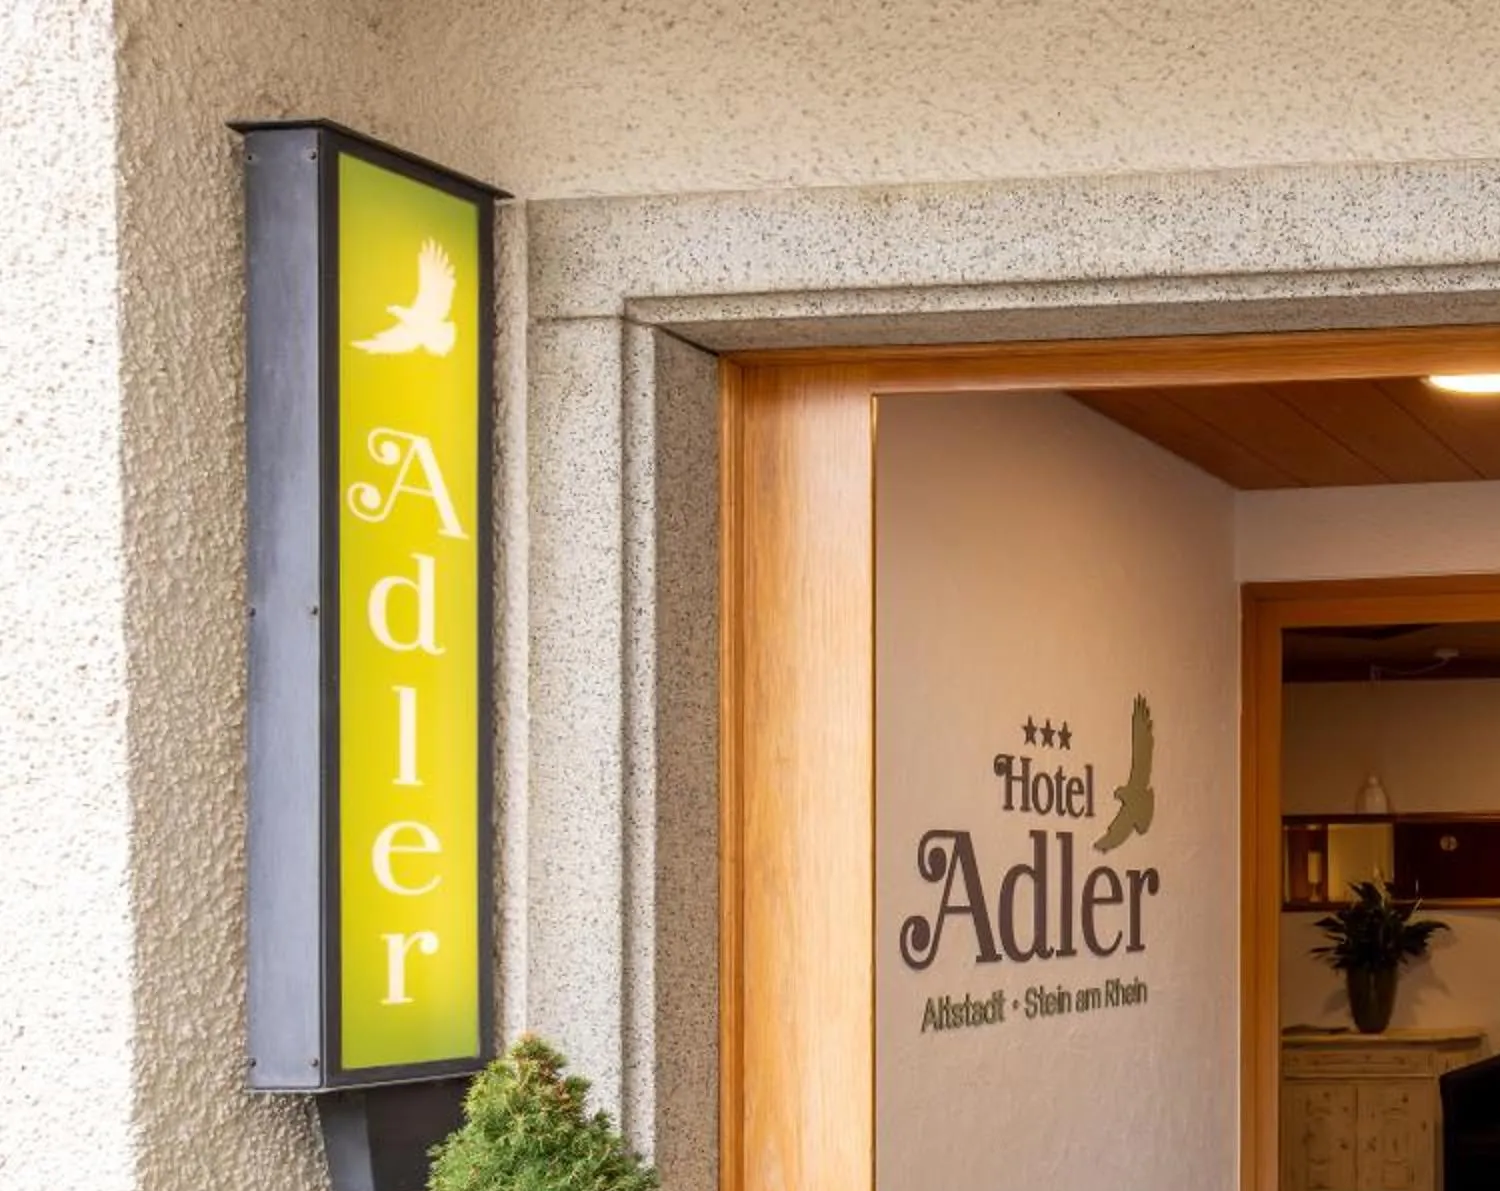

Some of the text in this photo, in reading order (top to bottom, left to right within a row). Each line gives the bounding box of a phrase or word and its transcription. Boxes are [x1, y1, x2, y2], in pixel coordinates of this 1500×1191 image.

[346, 426, 469, 1005] Adler
[994, 753, 1095, 818] Hotel
[900, 829, 1160, 970] Adler
[921, 976, 1148, 1033] Altstadt Stein am Rhein
